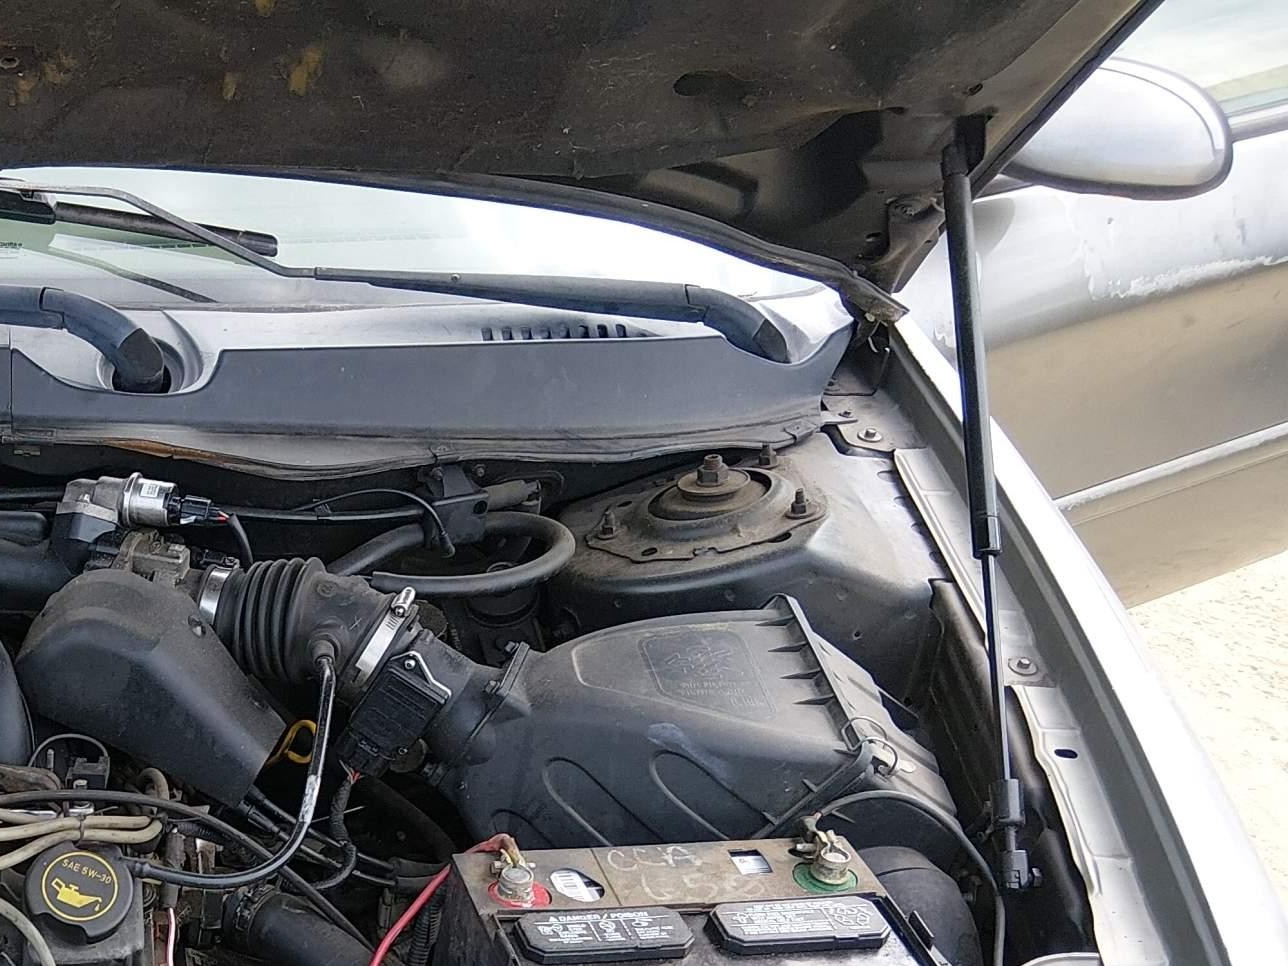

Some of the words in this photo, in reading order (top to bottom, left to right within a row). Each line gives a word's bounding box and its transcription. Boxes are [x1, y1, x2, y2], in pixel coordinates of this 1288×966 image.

[62, 859, 81, 872] SAE
[81, 866, 112, 884] 5W-30
[557, 914, 601, 922] DANGER
[610, 911, 649, 919] POISON
